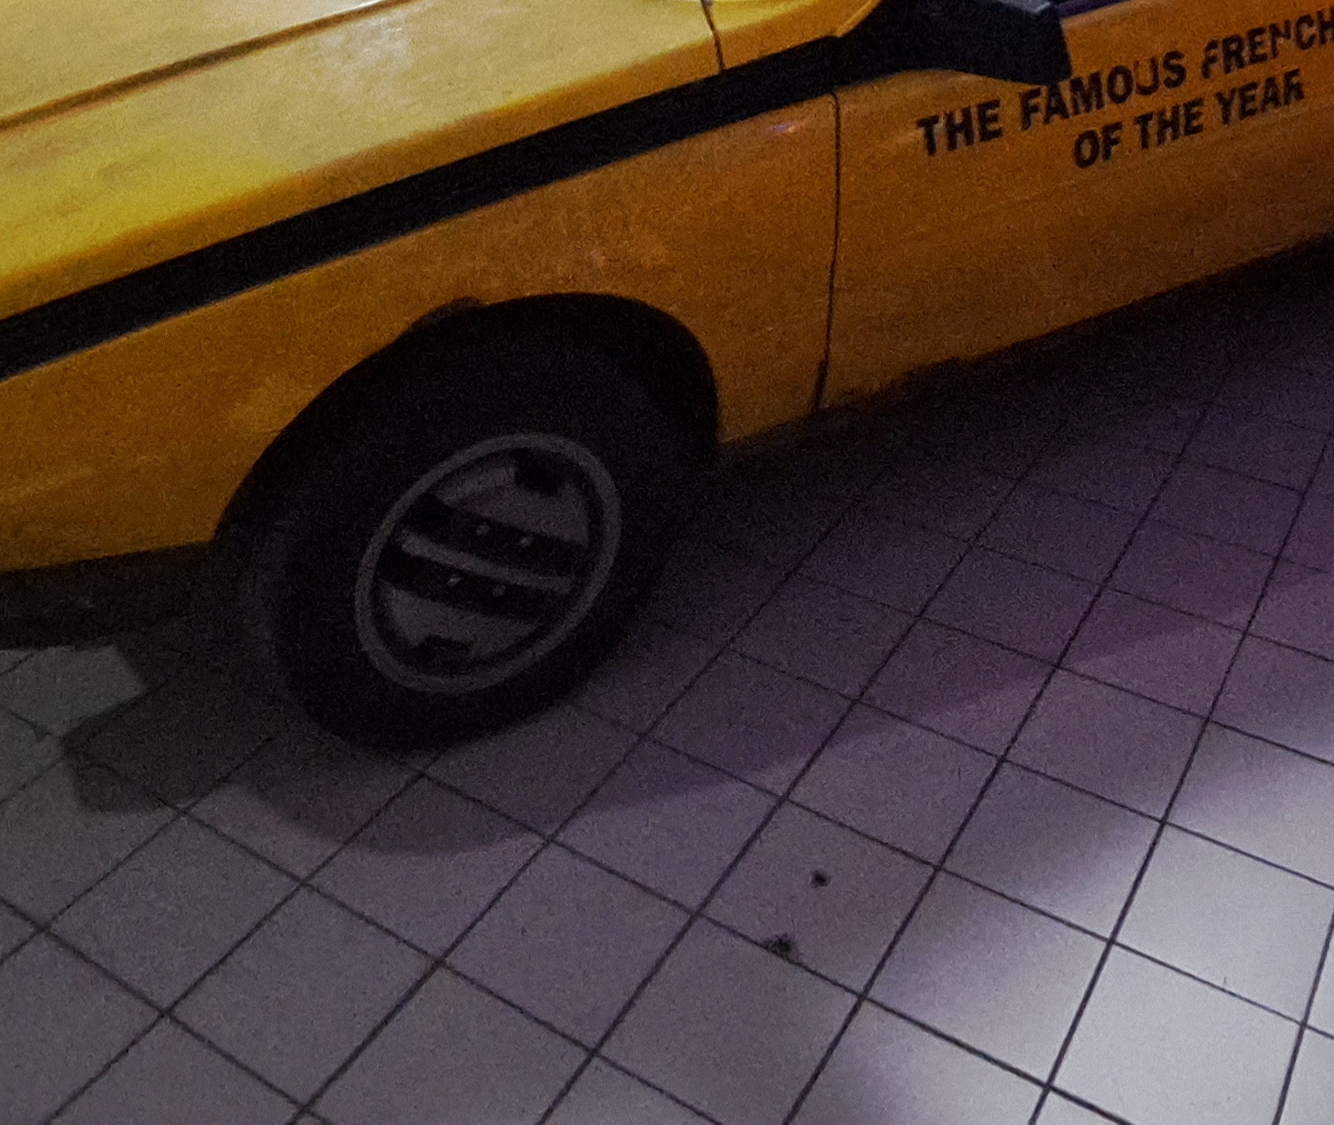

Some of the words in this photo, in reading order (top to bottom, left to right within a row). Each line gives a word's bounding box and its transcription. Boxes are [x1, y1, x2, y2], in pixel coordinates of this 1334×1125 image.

[917, 98, 1003, 157] THE
[1019, 49, 1187, 132] FAMOUS
[1073, 120, 1124, 168] OF
[1134, 97, 1204, 150] THE
[1214, 68, 1305, 125] YEAR
